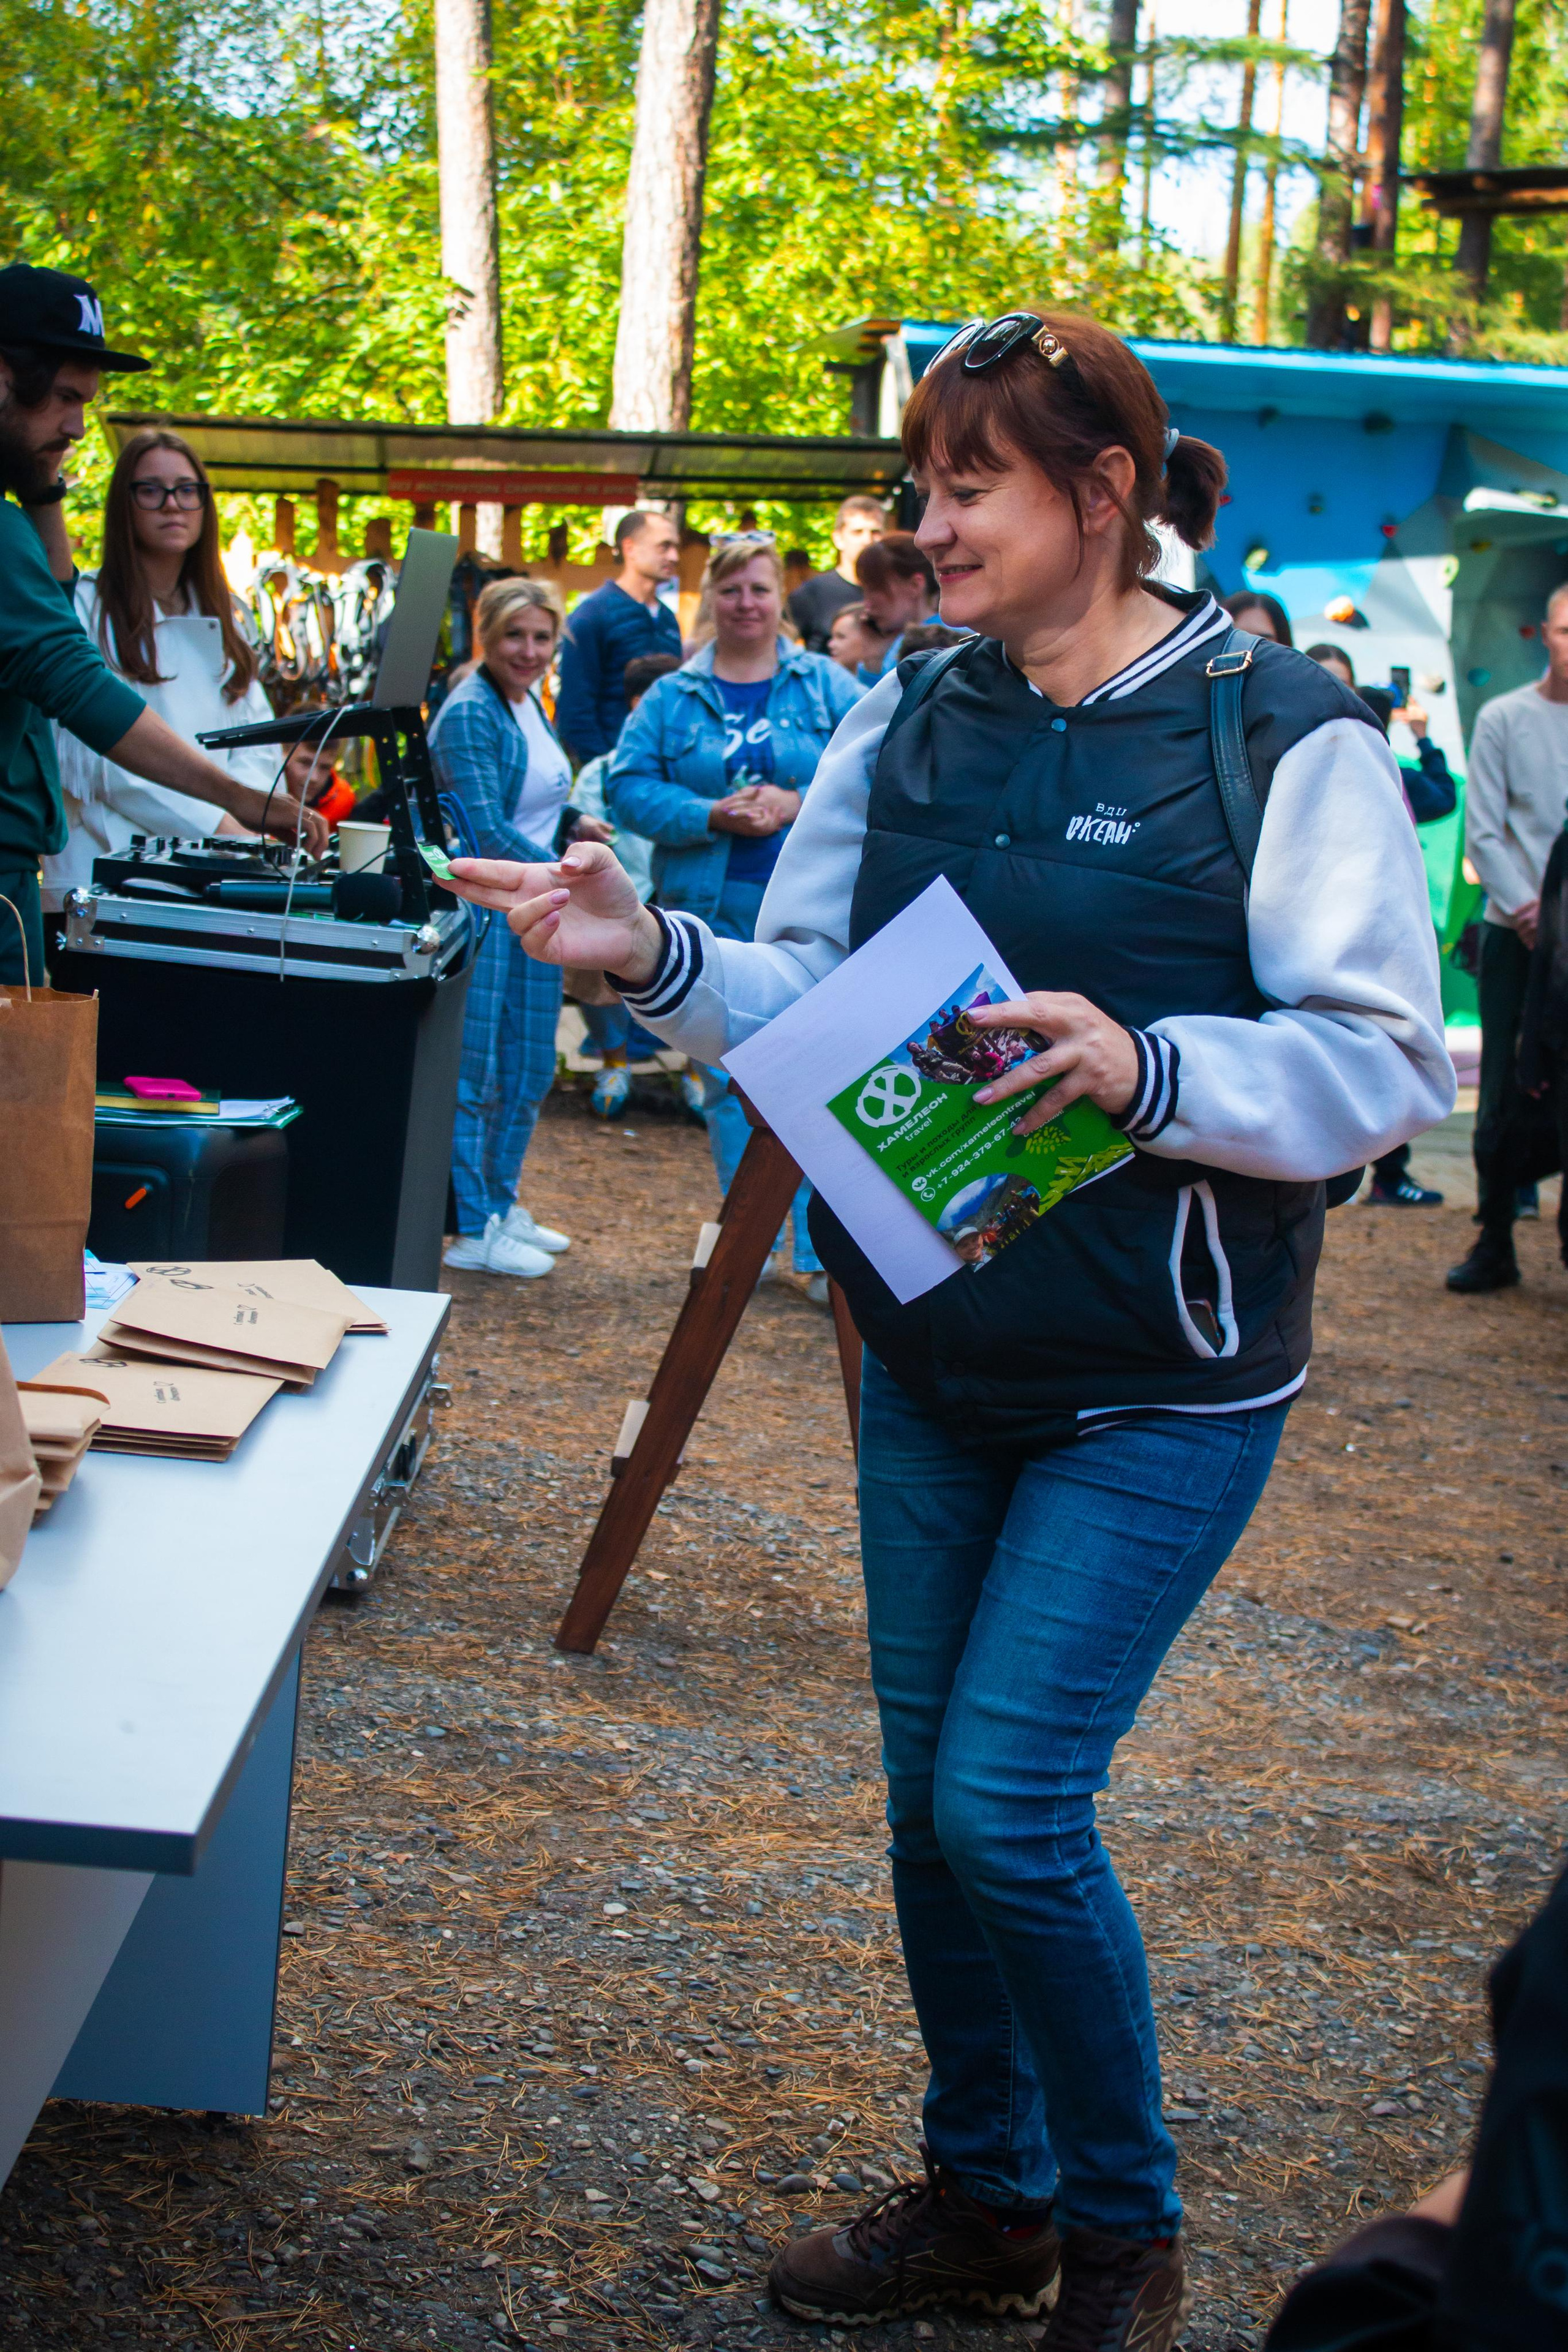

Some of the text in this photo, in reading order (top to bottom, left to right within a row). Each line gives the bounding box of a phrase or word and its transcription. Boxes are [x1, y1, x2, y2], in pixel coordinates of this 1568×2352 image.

[876, 1093, 948, 1153] ХАМЕЛЕОН
[895, 1152, 919, 1172] Туры
[927, 1118, 960, 1147] походы
[905, 1117, 933, 1142] travel
[910, 1137, 951, 1172] взрослых
[951, 1115, 976, 1138] групп
[925, 1091, 1036, 1179] vk.com/xameleontravel
